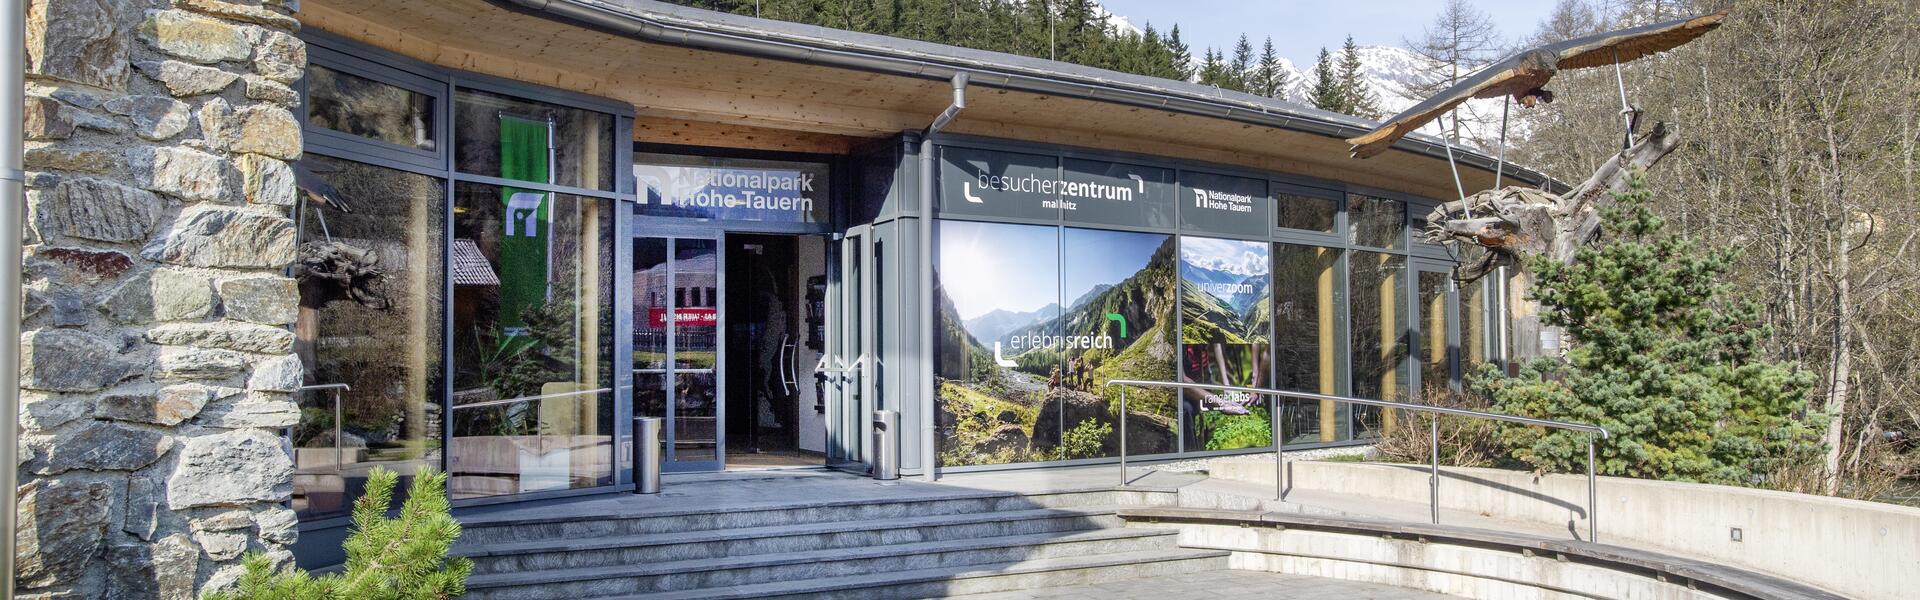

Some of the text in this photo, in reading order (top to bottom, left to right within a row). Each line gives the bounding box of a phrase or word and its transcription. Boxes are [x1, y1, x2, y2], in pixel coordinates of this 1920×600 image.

[978, 169, 1132, 201] besucherzentrum
[742, 191, 813, 211] Tauern
[1209, 190, 1252, 204] Nationalpark
[1209, 200, 1252, 213] Hohe Tauern
[1197, 280, 1253, 294] univerzoom
[1011, 331, 1112, 349] erlebnsreich
[1204, 390, 1250, 407] rangerlabs
